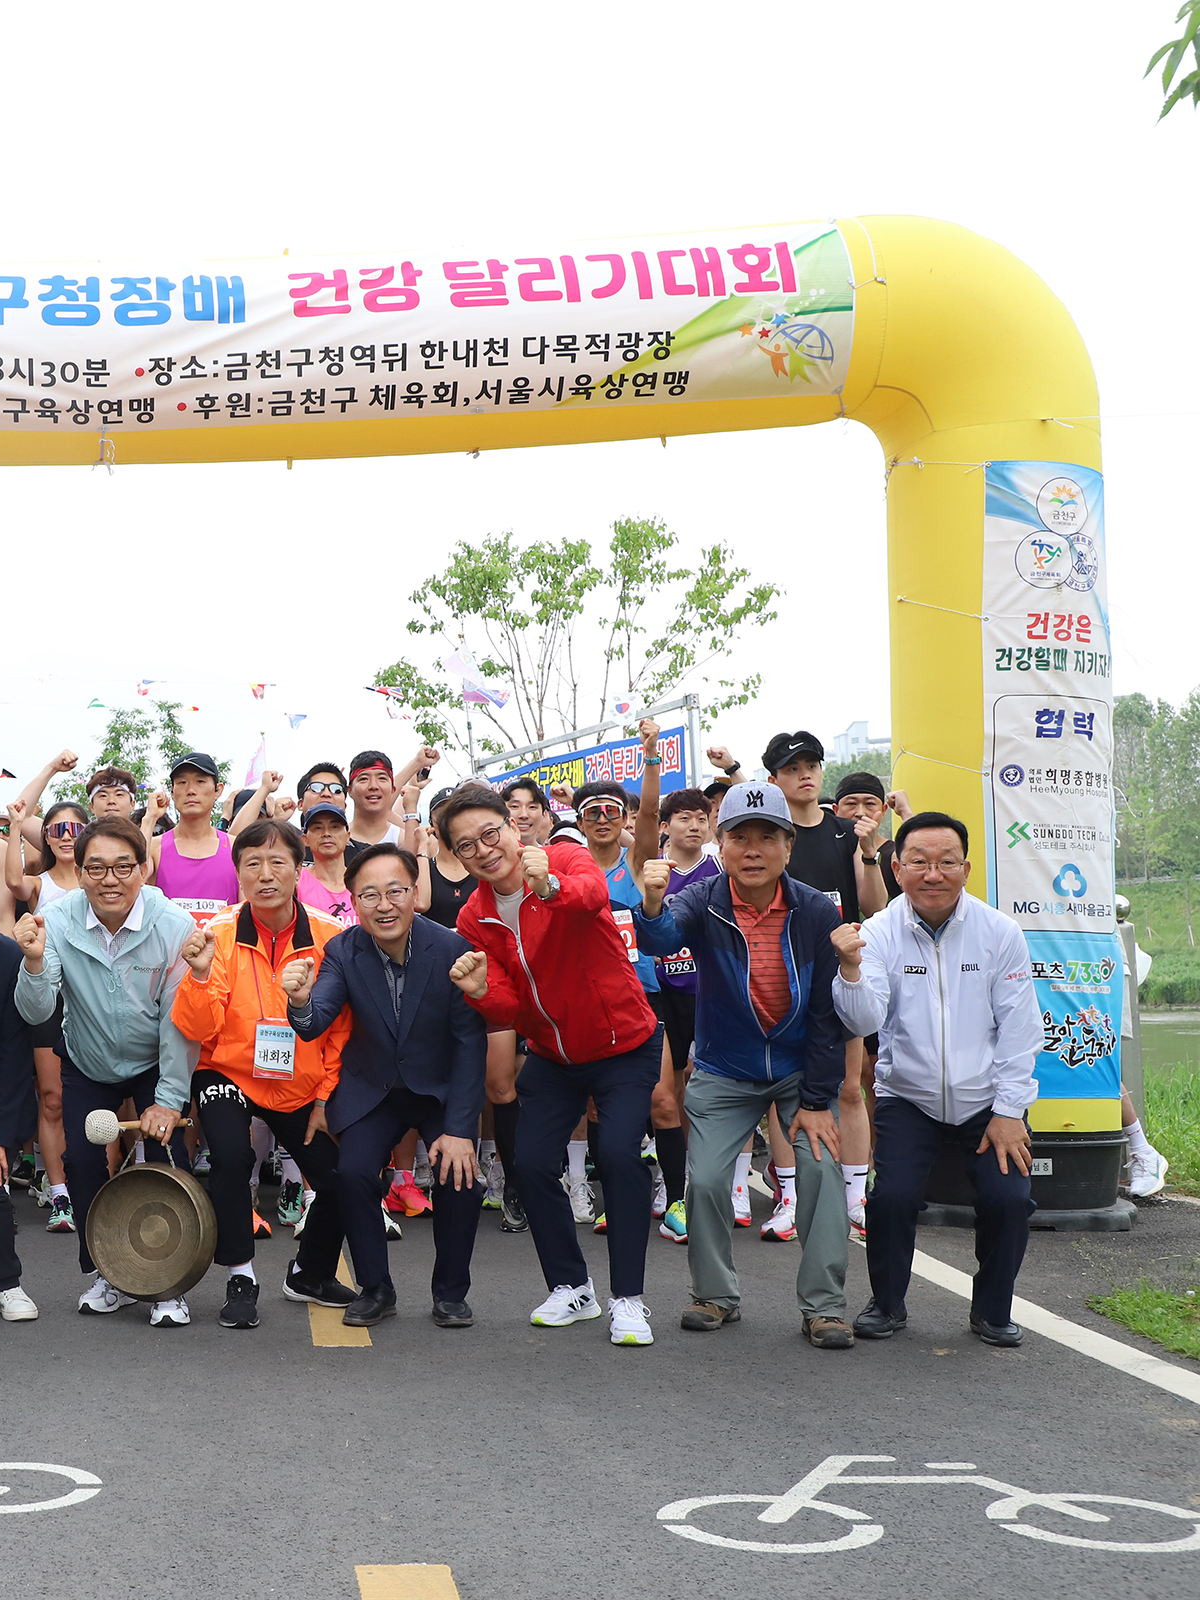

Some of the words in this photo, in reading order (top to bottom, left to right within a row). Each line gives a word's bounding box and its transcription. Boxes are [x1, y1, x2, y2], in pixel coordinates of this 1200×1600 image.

[287, 260, 422, 317] 건강
[442, 241, 797, 308] 달리기대회
[148, 343, 407, 386] 장소:금천구청역뒤
[420, 337, 510, 371] 한내천
[522, 330, 676, 365] 다목적광장
[193, 386, 358, 420] 후원:금천구
[1052, 510, 1076, 521] 금천구
[1026, 612, 1092, 643] 건강은
[995, 647, 1068, 671] 건강할때
[1074, 650, 1111, 678] 지키자!
[520, 758, 585, 795] 천구청장배
[1045, 768, 1108, 789] 희명종합병원
[1030, 785, 1084, 797] HeeMyoung
[1033, 829, 1073, 839] SUNGDO
[1077, 830, 1096, 841] TECH
[1034, 842, 1067, 851] 성도테크
[196, 901, 215, 910] 109
[961, 963, 980, 972] EOUL
[1031, 962, 1065, 979] 포츠
[258, 1049, 292, 1065] 대회장
